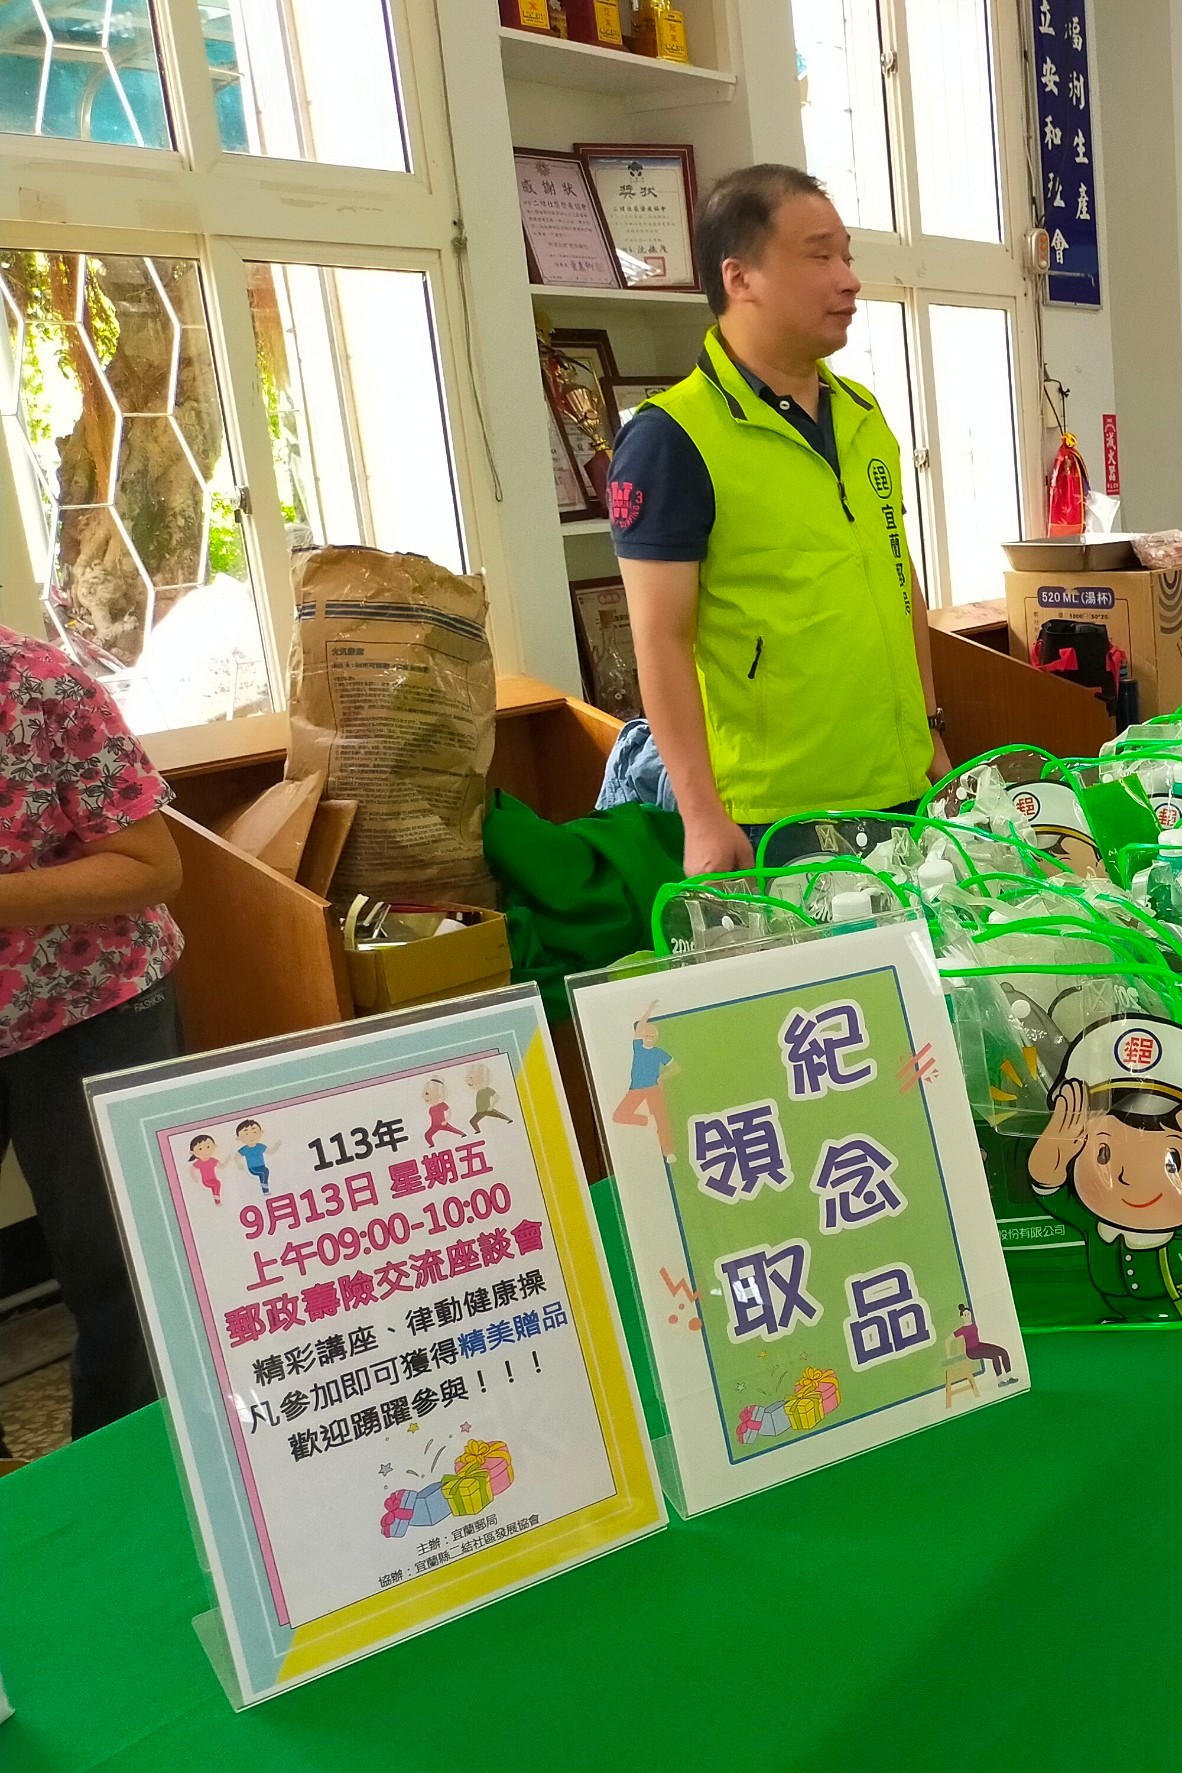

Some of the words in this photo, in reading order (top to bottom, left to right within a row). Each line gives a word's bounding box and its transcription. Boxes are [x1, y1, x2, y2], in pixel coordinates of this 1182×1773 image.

[521, 179, 577, 197] 感謝狀
[1042, 592, 1060, 602] 520
[1063, 592, 1079, 603] ML
[1124, 1036, 1154, 1065] 郵
[239, 1171, 379, 1240] 9月13日
[389, 1140, 494, 1200] 星期五
[308, 1117, 409, 1171] 113年
[224, 1218, 544, 1348] 郵政壽險交流座談會
[246, 1183, 512, 1291] 上午09:00-10:00
[250, 1301, 569, 1435] 凡參加即可獲得精美贈品
[252, 1269, 548, 1387] 精彩講座、律動健康操
